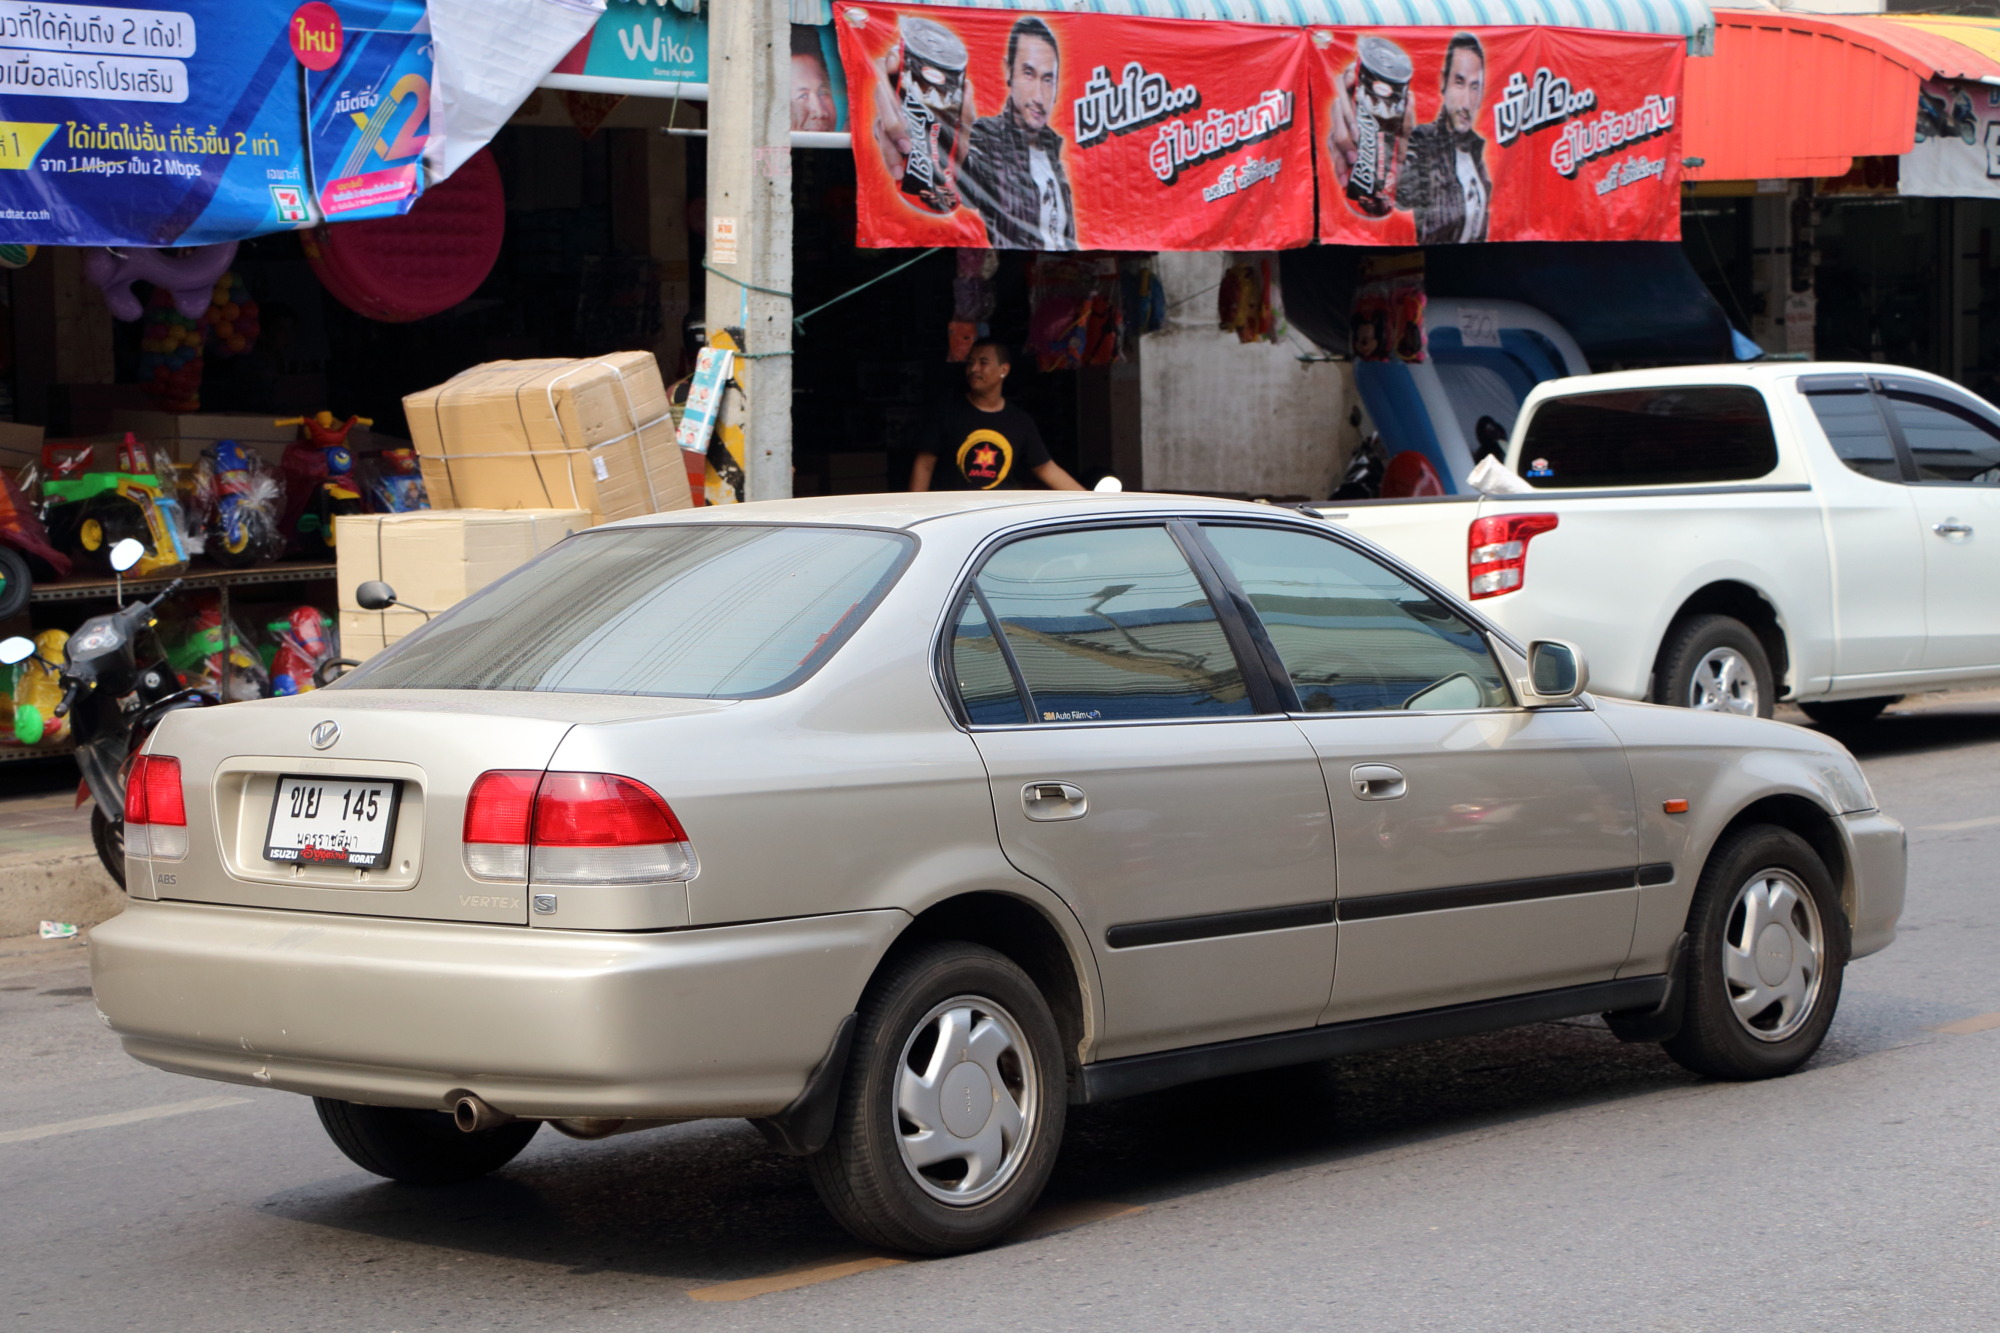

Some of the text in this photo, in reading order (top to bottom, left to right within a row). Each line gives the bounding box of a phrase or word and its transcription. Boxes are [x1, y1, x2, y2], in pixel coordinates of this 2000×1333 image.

[122, 19, 136, 45] 2
[144, 20, 183, 48] เด้ง!
[296, 17, 335, 53] ใหม่
[618, 17, 694, 64] Wiko
[11, 132, 20, 158] 1
[66, 121, 280, 156] ได้เน็ตไม่อั้น ที่เร็วขึ้น 2 เท่า
[40, 157, 202, 179] จาก 1 Mbps เป็น 2 Mbps
[1043, 712, 1055, 720] 3M
[1055, 712, 1071, 720] Auto
[291, 786, 382, 822] ขย 145
[297, 830, 359, 849] นครราชสีมา
[270, 849, 298, 860] ISUZU
[349, 854, 375, 864] KORAT
[157, 873, 177, 885] ABS
[460, 895, 520, 909] VERTEX
